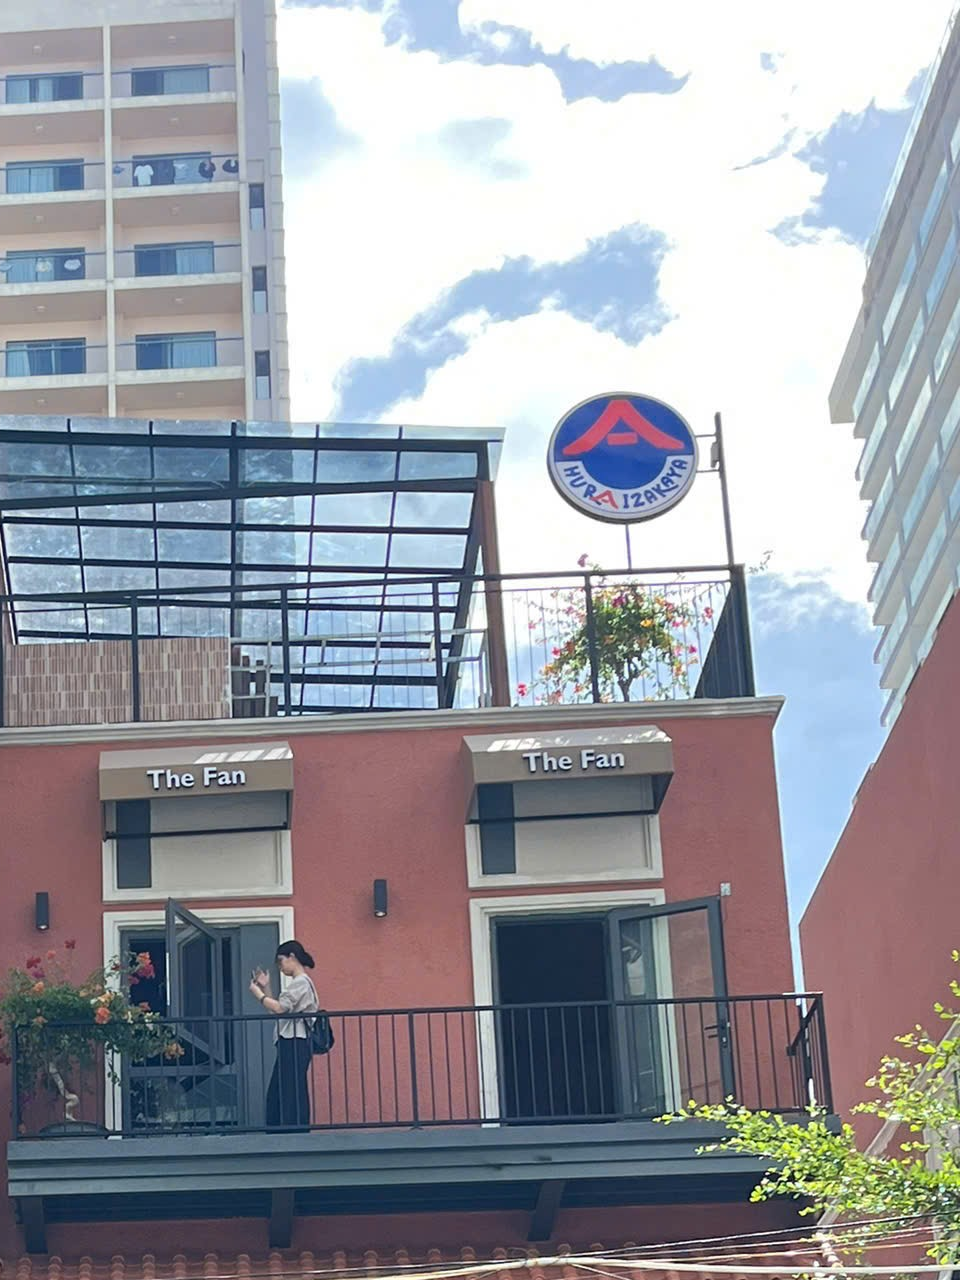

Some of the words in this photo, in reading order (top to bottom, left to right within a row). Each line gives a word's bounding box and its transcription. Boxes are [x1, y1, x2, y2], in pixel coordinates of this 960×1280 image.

[623, 458, 688, 508] IZAKAYA
[522, 751, 573, 773] The
[581, 749, 626, 770] Fan
[147, 768, 195, 789] The
[203, 766, 246, 786] Fan
